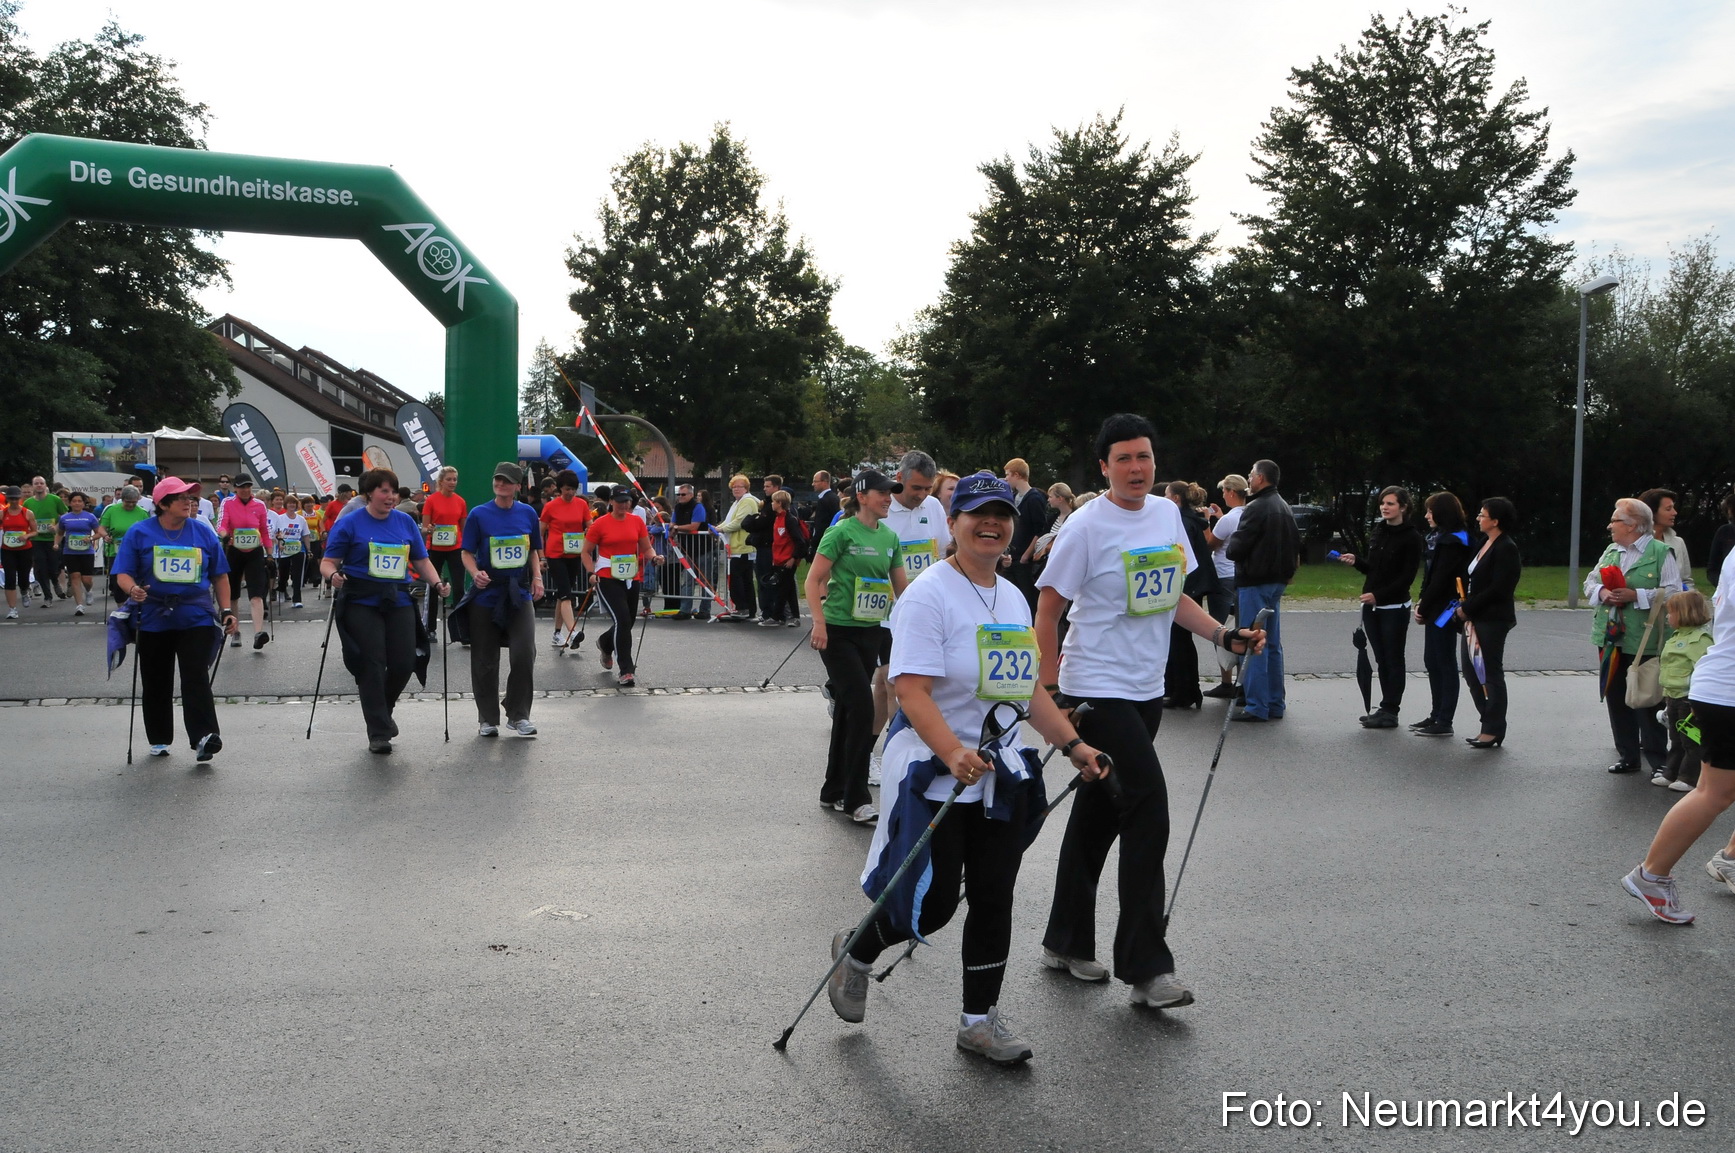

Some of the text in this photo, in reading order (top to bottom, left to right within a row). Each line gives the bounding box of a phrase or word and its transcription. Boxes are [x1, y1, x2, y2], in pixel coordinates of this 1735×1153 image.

[70, 160, 359, 206] Die Gesundheitskasse.
[381, 222, 490, 312] AOK
[61, 446, 95, 457] TLA
[235, 535, 257, 544] 1327
[437, 532, 449, 540] 52
[568, 540, 579, 548] 54
[495, 546, 522, 560] 158
[160, 558, 191, 573] 154
[374, 555, 401, 569] 157
[618, 563, 631, 573] 57
[906, 554, 931, 570] 191
[1134, 567, 1176, 599] 237
[857, 593, 887, 609] 1196
[988, 650, 1033, 680] 232
